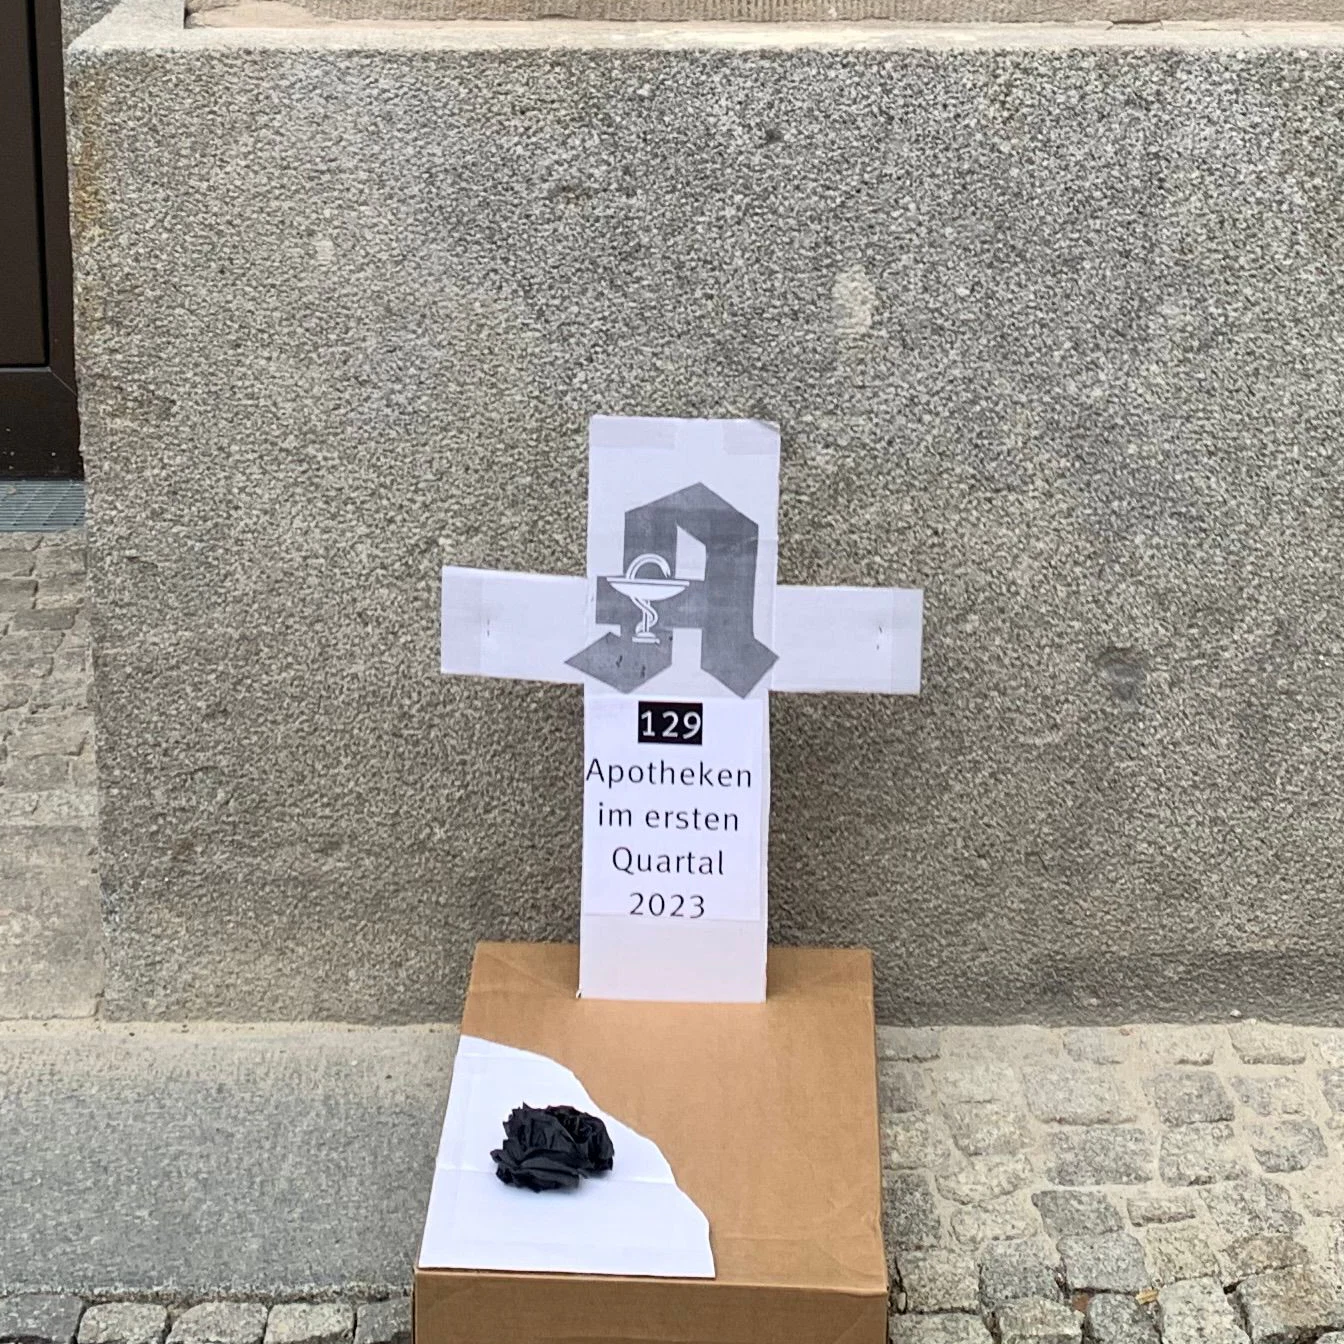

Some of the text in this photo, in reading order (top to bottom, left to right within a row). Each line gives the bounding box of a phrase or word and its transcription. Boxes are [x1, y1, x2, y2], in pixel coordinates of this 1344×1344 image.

[640, 709, 702, 740] 129
[585, 758, 751, 789] Apotheken
[599, 801, 738, 832] im ersten
[612, 846, 724, 876] Quartal
[629, 892, 705, 919] 2023
